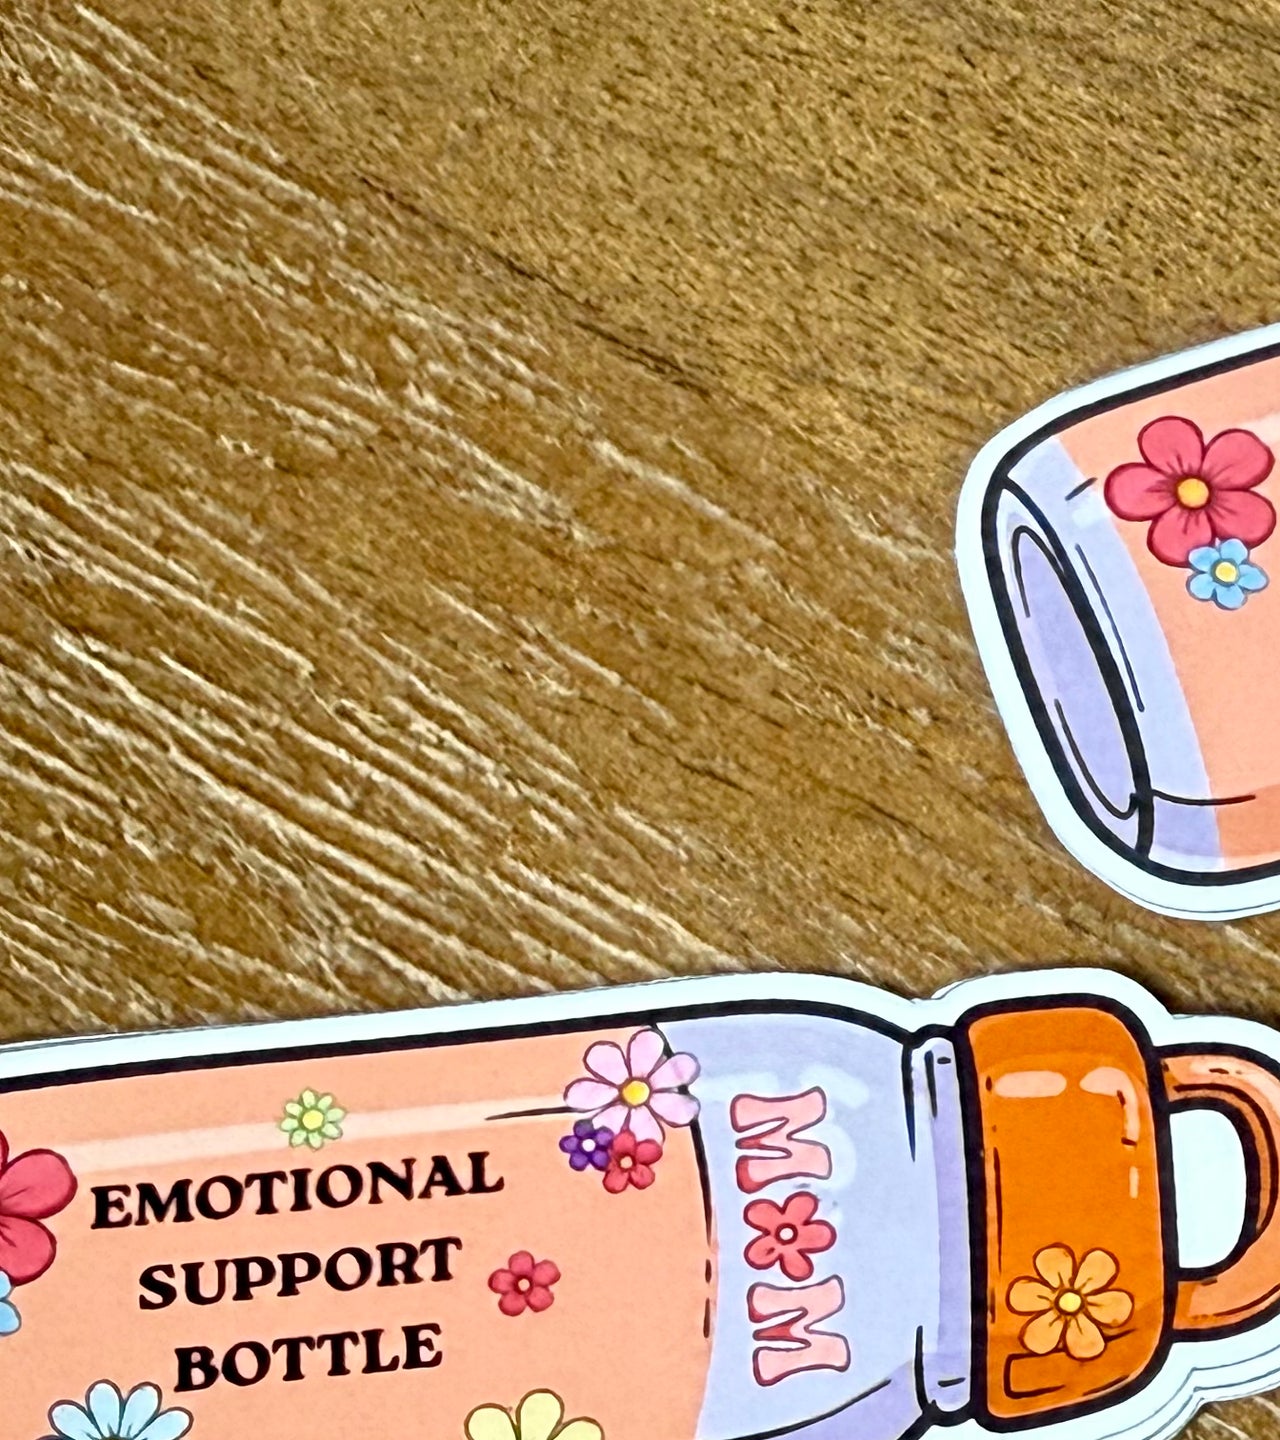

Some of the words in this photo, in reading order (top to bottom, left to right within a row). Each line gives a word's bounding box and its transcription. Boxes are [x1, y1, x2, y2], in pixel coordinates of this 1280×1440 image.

[89, 1150, 506, 1231] EMOTIONAL
[138, 1236, 463, 1311] SUPPORT
[172, 1322, 444, 1394] BOTTLE
